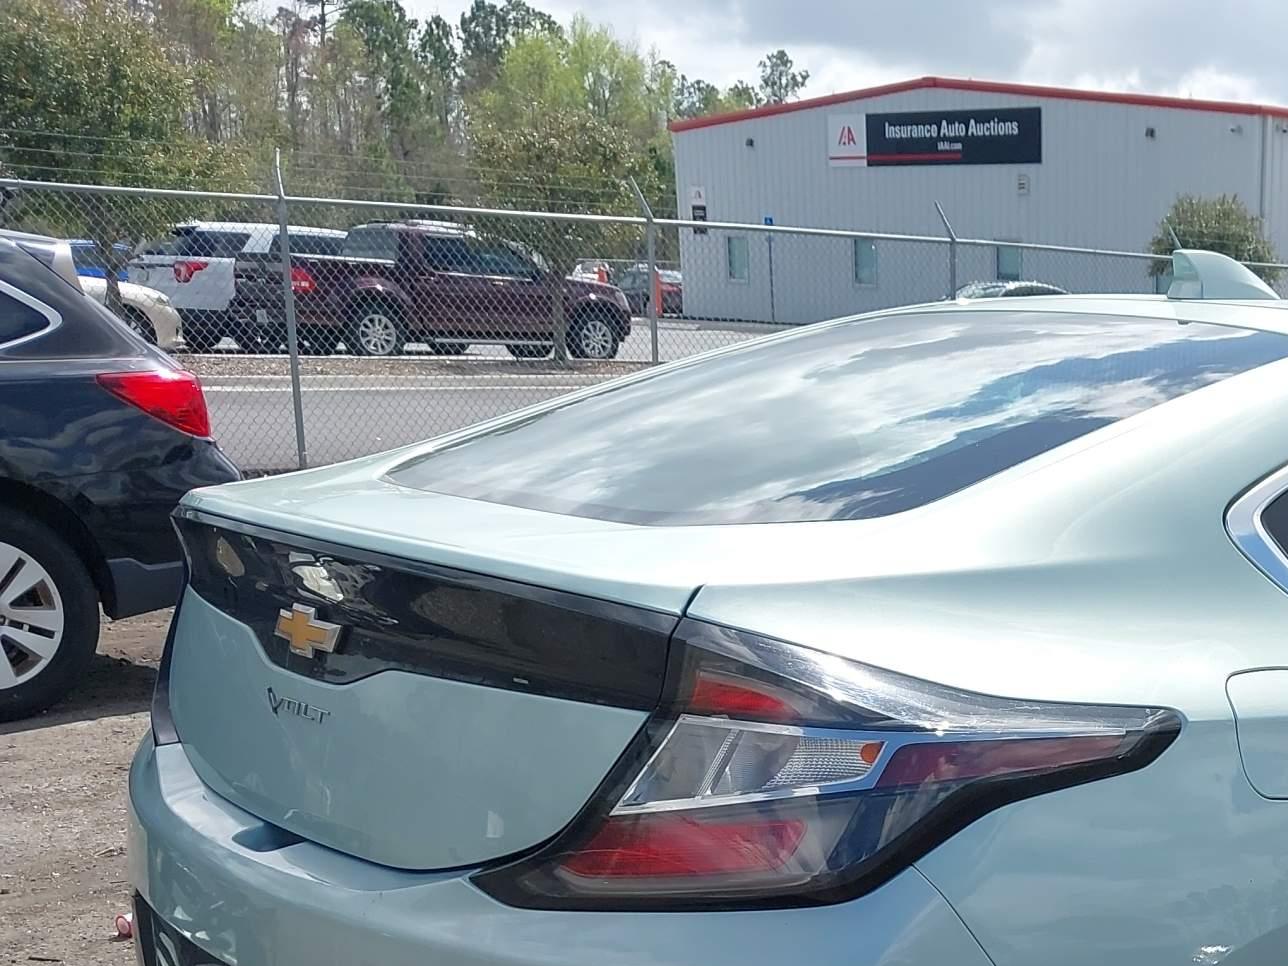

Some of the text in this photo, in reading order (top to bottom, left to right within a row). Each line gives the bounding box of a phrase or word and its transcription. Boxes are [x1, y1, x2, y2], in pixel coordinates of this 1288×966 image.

[885, 117, 1019, 139] Insurance Auto Auctions
[267, 687, 331, 723] VOLT
